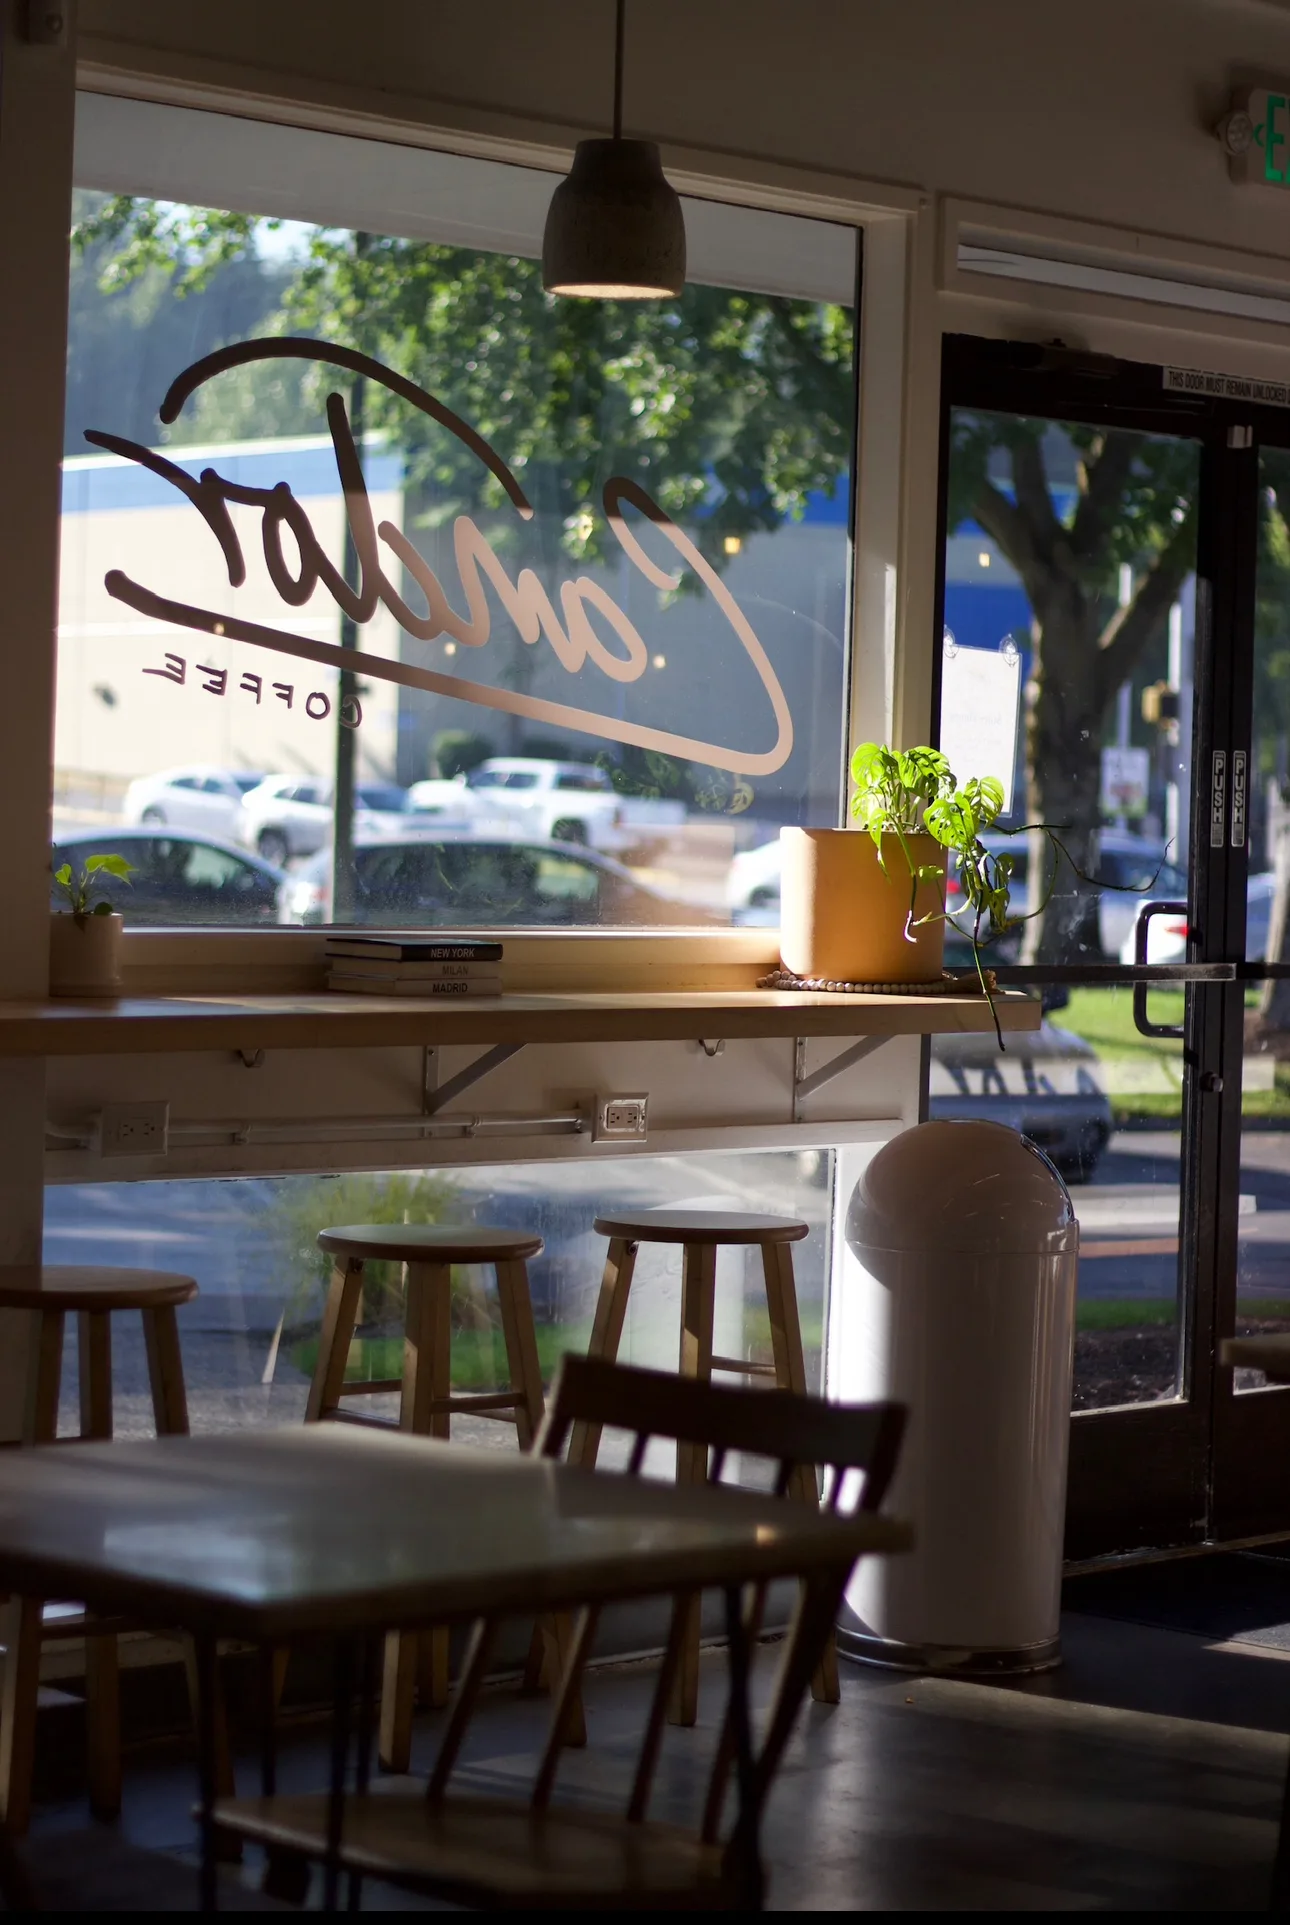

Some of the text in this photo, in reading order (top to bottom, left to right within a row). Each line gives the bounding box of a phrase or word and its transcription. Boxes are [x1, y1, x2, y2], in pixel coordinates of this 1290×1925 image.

[1265, 94, 1290, 184] E
[1168, 371, 1184, 388] THIS
[1185, 373, 1205, 390] DOOR
[1206, 376, 1225, 394] MUST
[1226, 379, 1252, 398] REMAIN
[1253, 382, 1287, 403] UNLOCKED
[1213, 758, 1224, 823] PUSH
[1234, 758, 1244, 823] PUSH
[430, 948, 475, 958] NEW YORK
[442, 965, 468, 976] MILAN
[432, 982, 468, 993] MADRID
